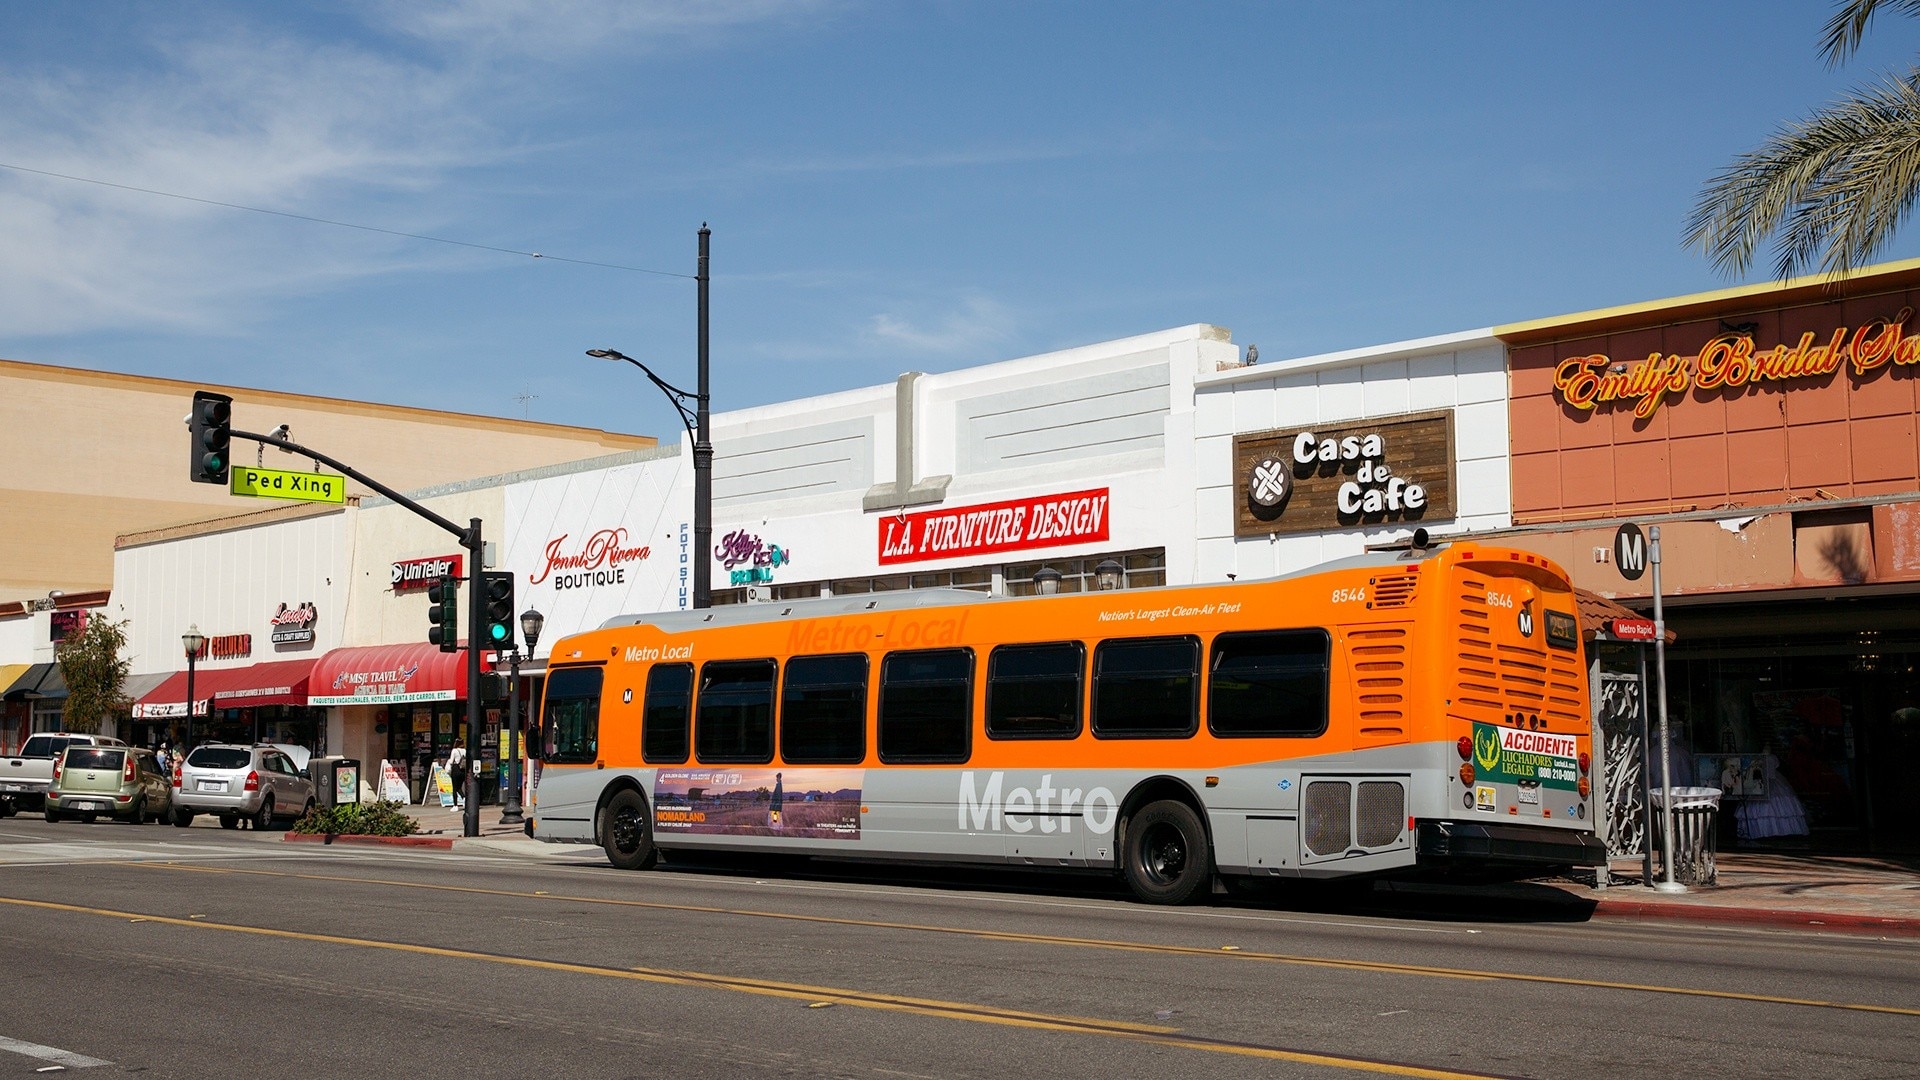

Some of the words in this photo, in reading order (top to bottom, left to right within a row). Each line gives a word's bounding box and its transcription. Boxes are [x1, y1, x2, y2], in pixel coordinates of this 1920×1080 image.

[1554, 352, 1690, 418] Emily's
[1695, 327, 1847, 390] Bridal
[1293, 431, 1382, 464] Casa
[1357, 460, 1389, 483] de
[246, 472, 282, 489] Ped
[291, 476, 331, 497] Xing
[1337, 477, 1425, 514] Cafe
[882, 520, 914, 558] L.A.
[919, 505, 1026, 553] FURNITURE
[1027, 496, 1107, 541] DESIGN
[680, 523, 688, 563] FOTO
[714, 529, 763, 571] Kelly's
[1620, 531, 1644, 572] M
[530, 533, 588, 585] Jenni
[585, 528, 651, 570] Rivera
[404, 560, 452, 580] UniTeller
[556, 569, 624, 590] BOUTIQUE
[731, 567, 773, 586] BRIDAL
[679, 567, 687, 611] STUD
[1331, 587, 1365, 604] 8546
[1487, 591, 1513, 608] 8546
[1098, 609, 1135, 621] Nation's
[1136, 608, 1170, 622] Largest
[1172, 604, 1215, 617] Clean-Air
[1217, 602, 1241, 614] Fleet
[1519, 612, 1532, 634] M
[785, 620, 872, 653] Metro
[882, 609, 970, 649] Local
[1618, 623, 1636, 634] Metro
[1636, 624, 1652, 636] Rapid
[212, 633, 251, 657] CELLULAR
[624, 646, 659, 662] Metro
[661, 642, 694, 659] Local
[370, 670, 398, 683] TRAVEL
[623, 690, 632, 702] M
[1504, 732, 1574, 757] ACCIDENTE
[1502, 751, 1552, 767] LUCHADORES
[1502, 762, 1534, 777] LEGALES
[958, 771, 1117, 835] Metro
[657, 811, 705, 822] NOMADLAND
